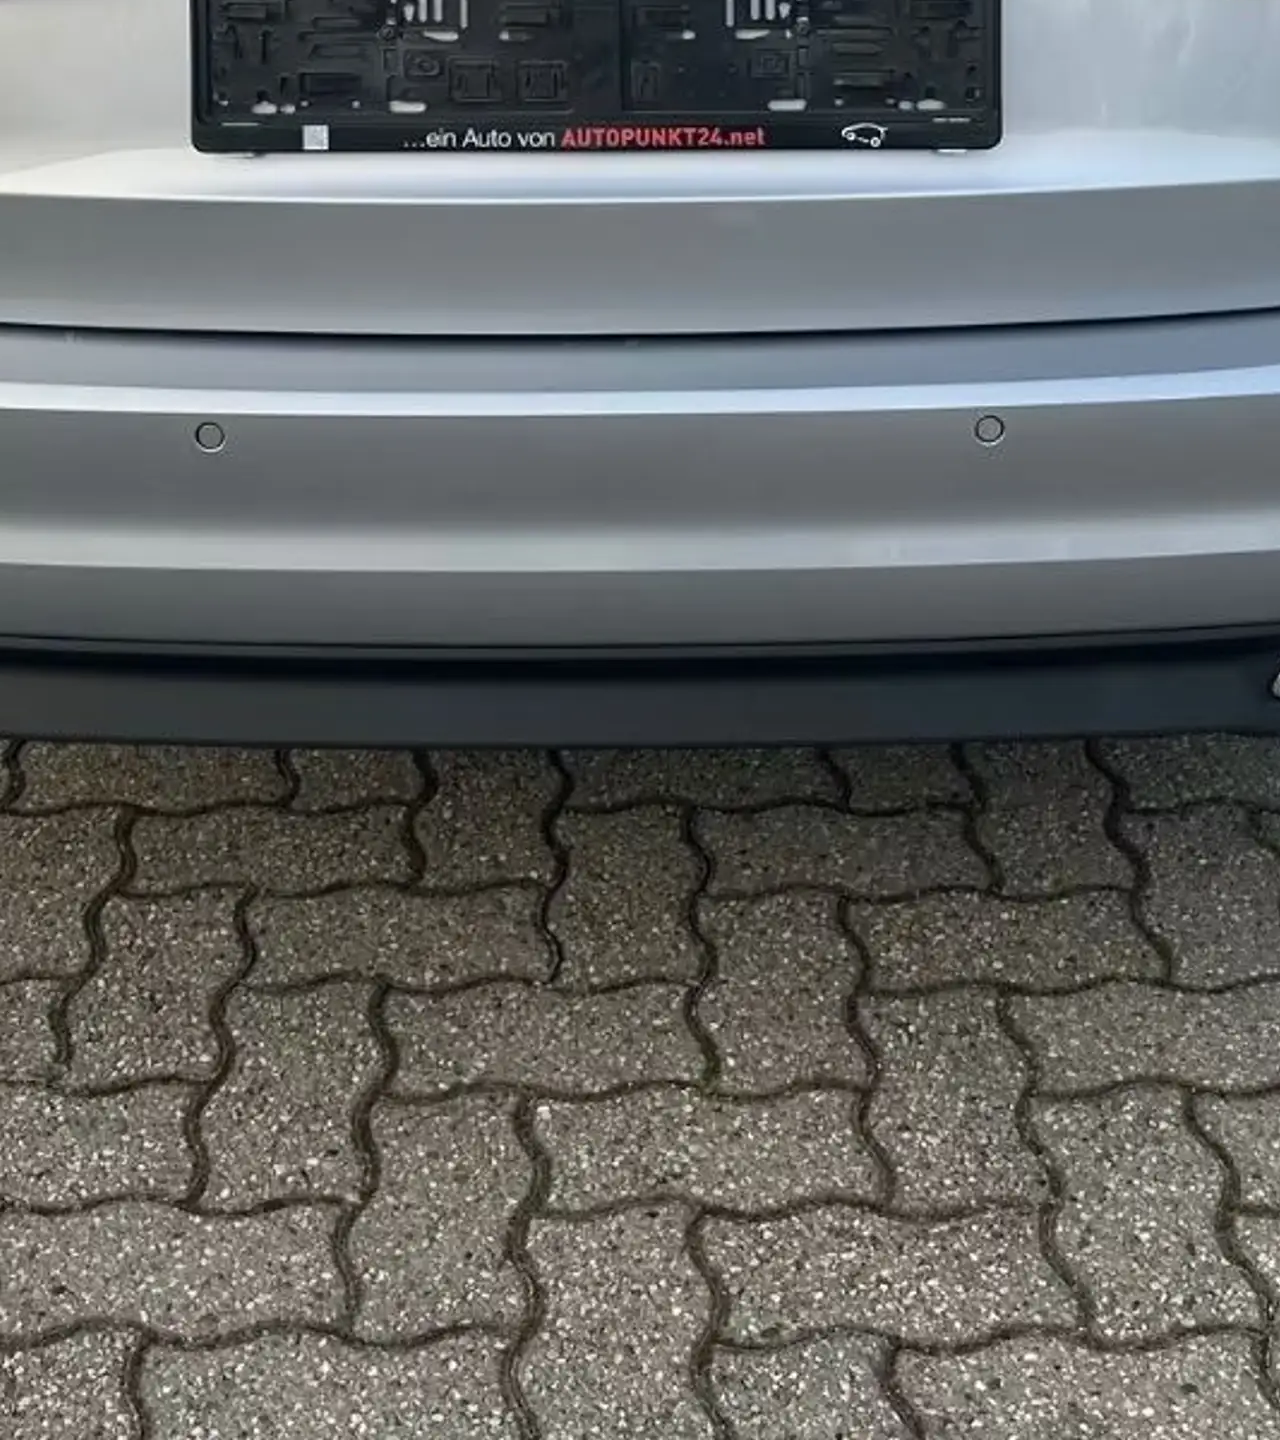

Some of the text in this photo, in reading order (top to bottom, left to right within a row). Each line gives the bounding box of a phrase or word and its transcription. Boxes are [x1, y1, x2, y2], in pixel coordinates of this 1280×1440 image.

[462, 127, 512, 148] Auto
[517, 132, 556, 148] von
[560, 126, 766, 148] AUTOPUNKT24.net
